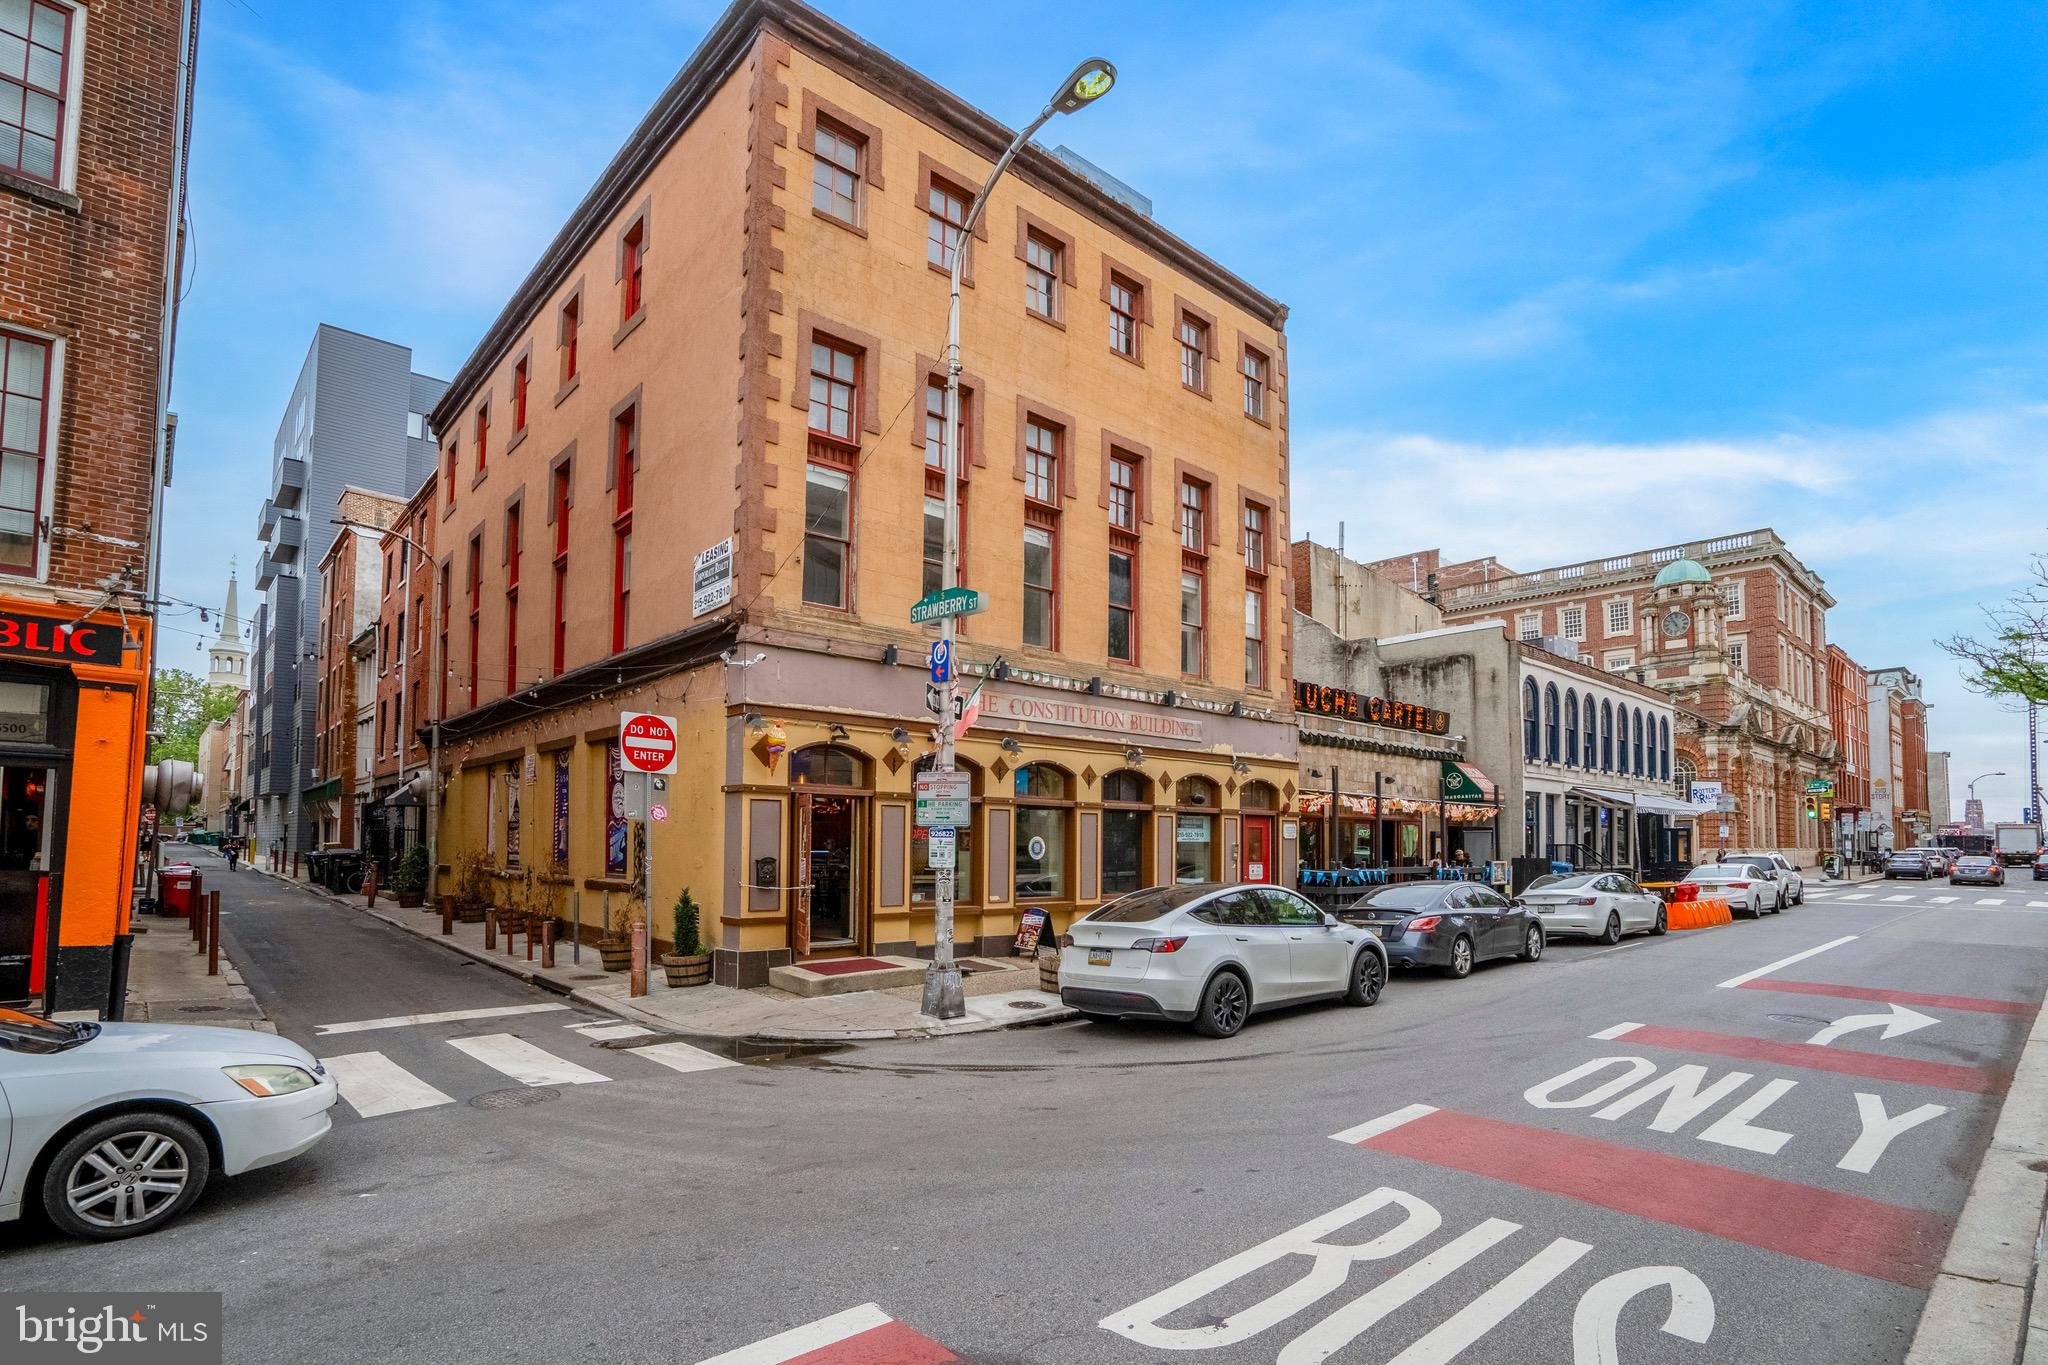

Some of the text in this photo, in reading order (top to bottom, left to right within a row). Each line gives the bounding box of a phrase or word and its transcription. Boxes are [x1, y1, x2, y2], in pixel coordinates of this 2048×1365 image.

[701, 541, 729, 565] LEASING
[694, 585, 730, 609] 215-922-7810
[911, 595, 977, 622] STRAWBERRY ST
[1009, 698, 1125, 728] CONSTITUTION
[1130, 714, 1194, 738] BUILDING
[1368, 696, 1433, 731] CARTEL
[630, 724, 669, 737] DO NOT
[633, 750, 665, 762] ENTER
[1523, 1056, 1952, 1174] ONLY
